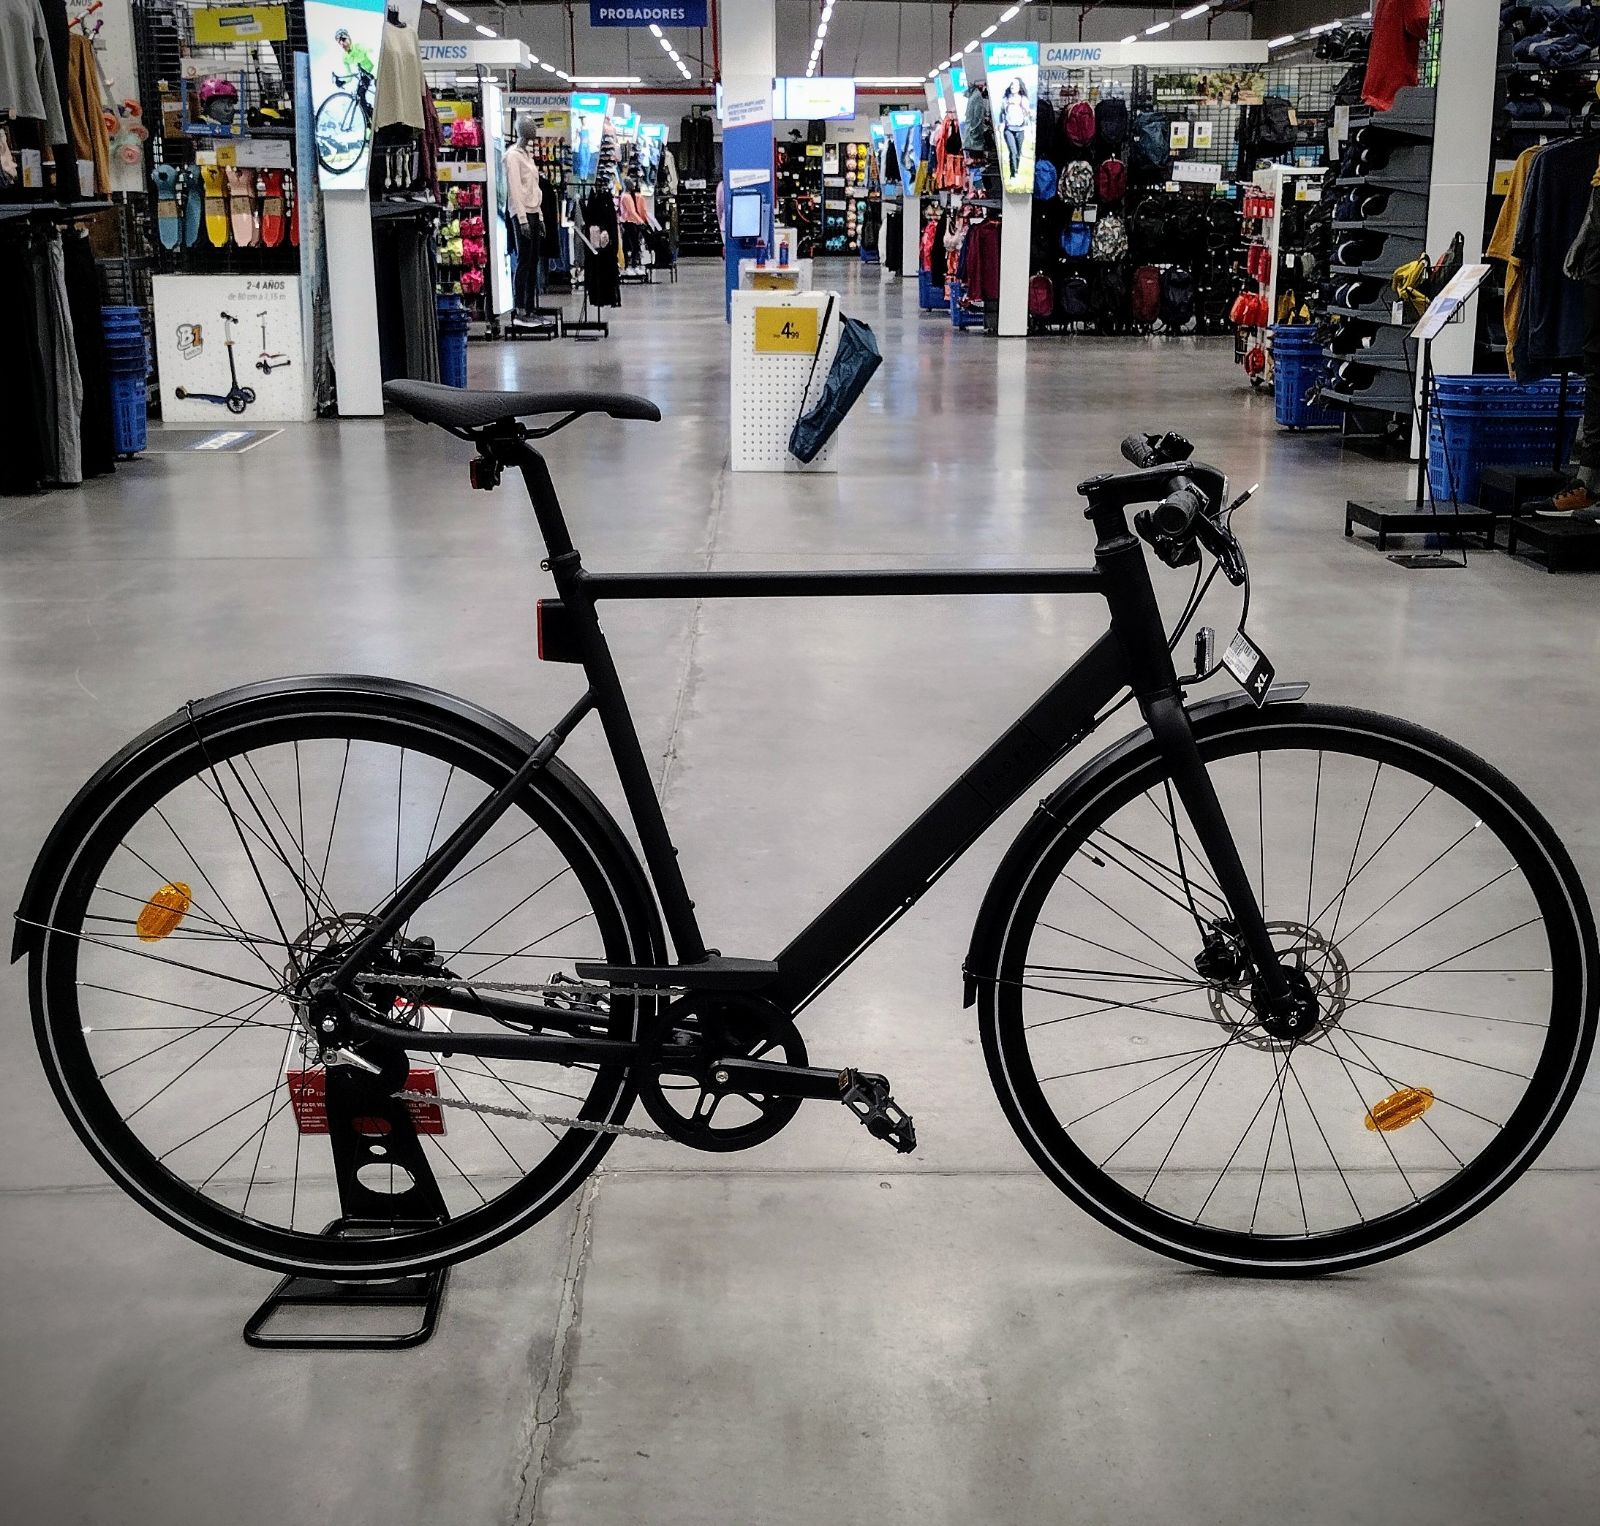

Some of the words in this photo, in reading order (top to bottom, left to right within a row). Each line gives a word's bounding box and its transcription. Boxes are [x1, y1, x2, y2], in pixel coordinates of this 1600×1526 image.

[600, 8, 684, 20] PROBADORES
[419, 45, 467, 59] FITNESS
[1046, 47, 1102, 62] CAMPING
[508, 95, 568, 106] MUSCULACIÓN
[247, 281, 260, 289] 2-4
[262, 280, 285, 290] AÑOS
[1254, 673, 1268, 693] XL
